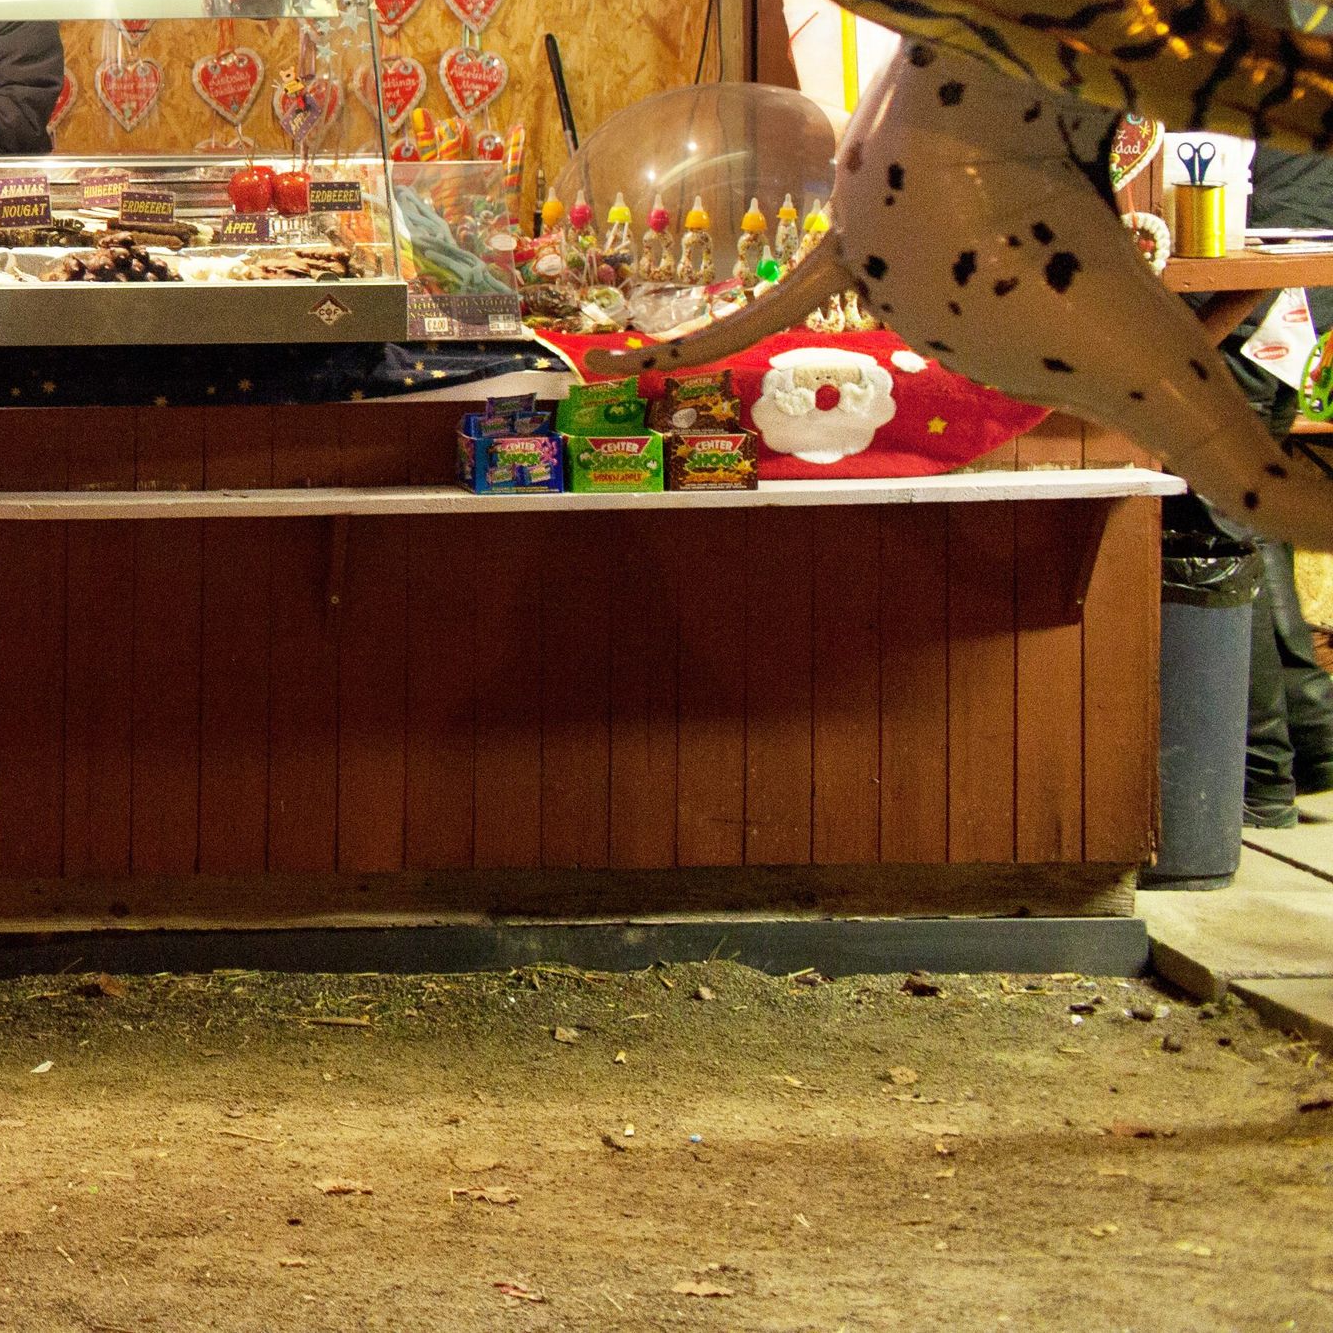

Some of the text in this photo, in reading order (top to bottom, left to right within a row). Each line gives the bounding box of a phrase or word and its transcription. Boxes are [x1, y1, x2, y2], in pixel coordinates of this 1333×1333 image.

[0, 182, 45, 196] ANANAS
[310, 189, 361, 203] ERDBEEREN
[2, 203, 48, 219] NOUGAT
[122, 200, 174, 214] ERDBEEREN
[600, 441, 640, 453] CENTER
[694, 440, 733, 453] CENTER
